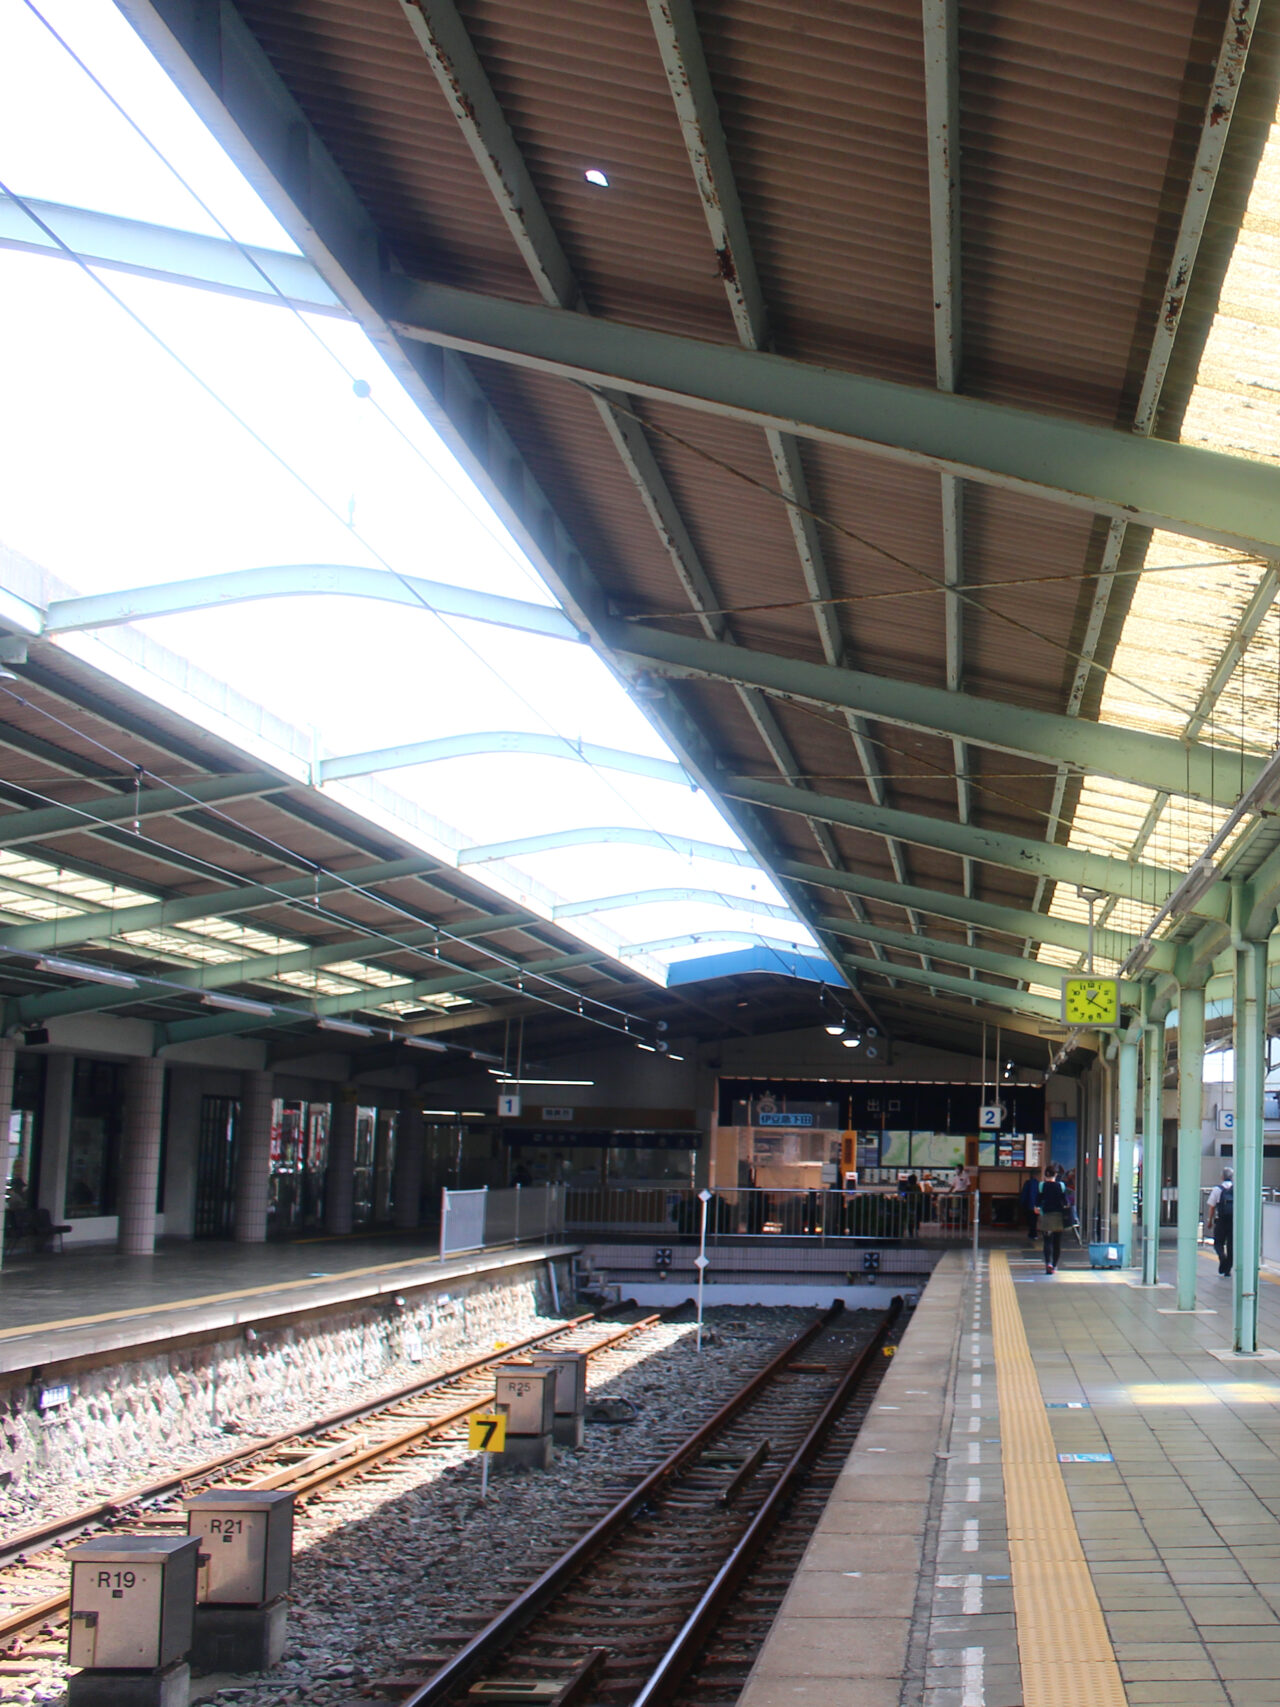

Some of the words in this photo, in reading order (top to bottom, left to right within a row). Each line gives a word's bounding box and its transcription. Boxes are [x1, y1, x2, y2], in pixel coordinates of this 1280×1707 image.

[505, 1099, 512, 1113] 1
[985, 1110, 995, 1124] 2
[1224, 1114, 1233, 1127] 3
[508, 1382, 531, 1393] R25
[476, 1421, 498, 1449] 7
[209, 1519, 243, 1534] R21
[97, 1571, 136, 1588] R19
